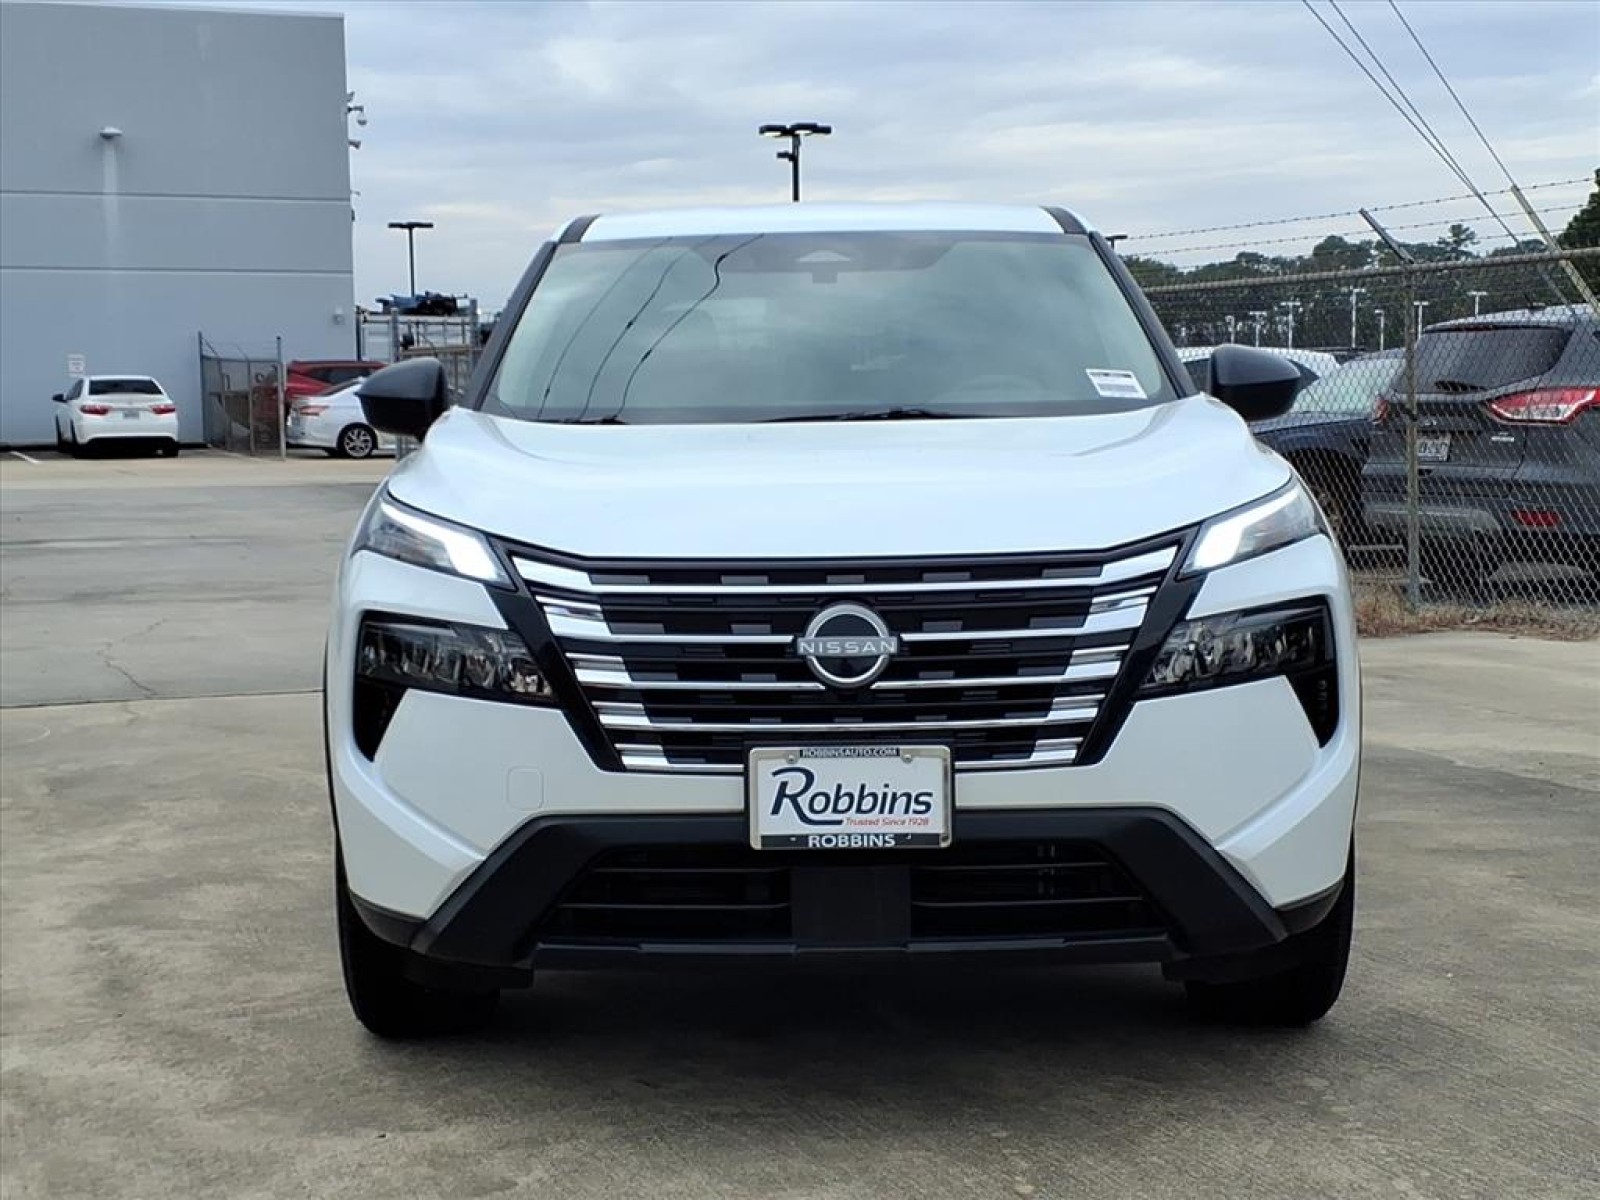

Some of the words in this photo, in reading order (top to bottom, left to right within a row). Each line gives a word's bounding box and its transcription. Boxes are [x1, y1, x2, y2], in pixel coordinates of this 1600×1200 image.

[799, 641, 895, 654] NISSAN
[802, 748, 898, 758] ROBBINSAUTO.COM
[770, 766, 934, 826] Robbins
[846, 817, 881, 826] Trusted
[882, 817, 906, 826] Since
[907, 817, 929, 826] 1928
[808, 835, 896, 848] ROBBINS
